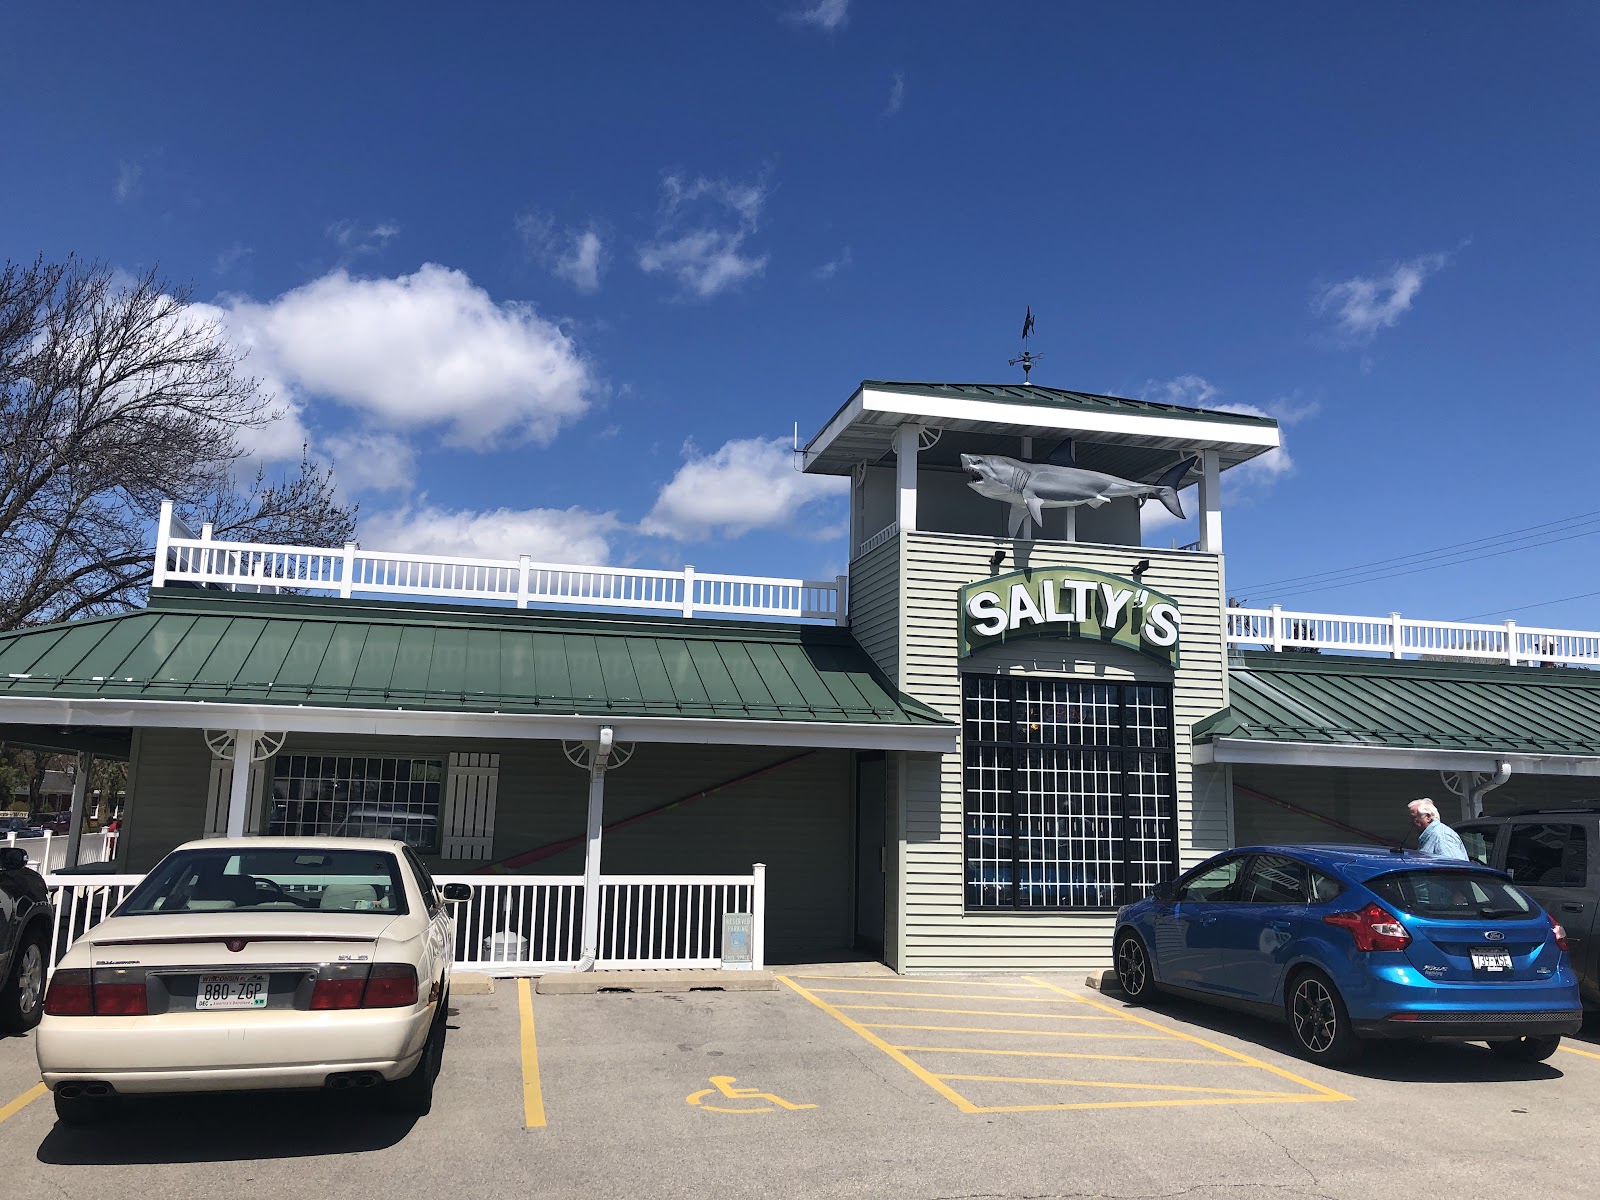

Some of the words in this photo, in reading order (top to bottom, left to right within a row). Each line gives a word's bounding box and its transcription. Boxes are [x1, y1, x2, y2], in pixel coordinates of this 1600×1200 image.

[965, 579, 1182, 647] SALTY'S
[725, 917, 751, 925] RESERVED
[204, 983, 262, 1000] 880-ZGP
